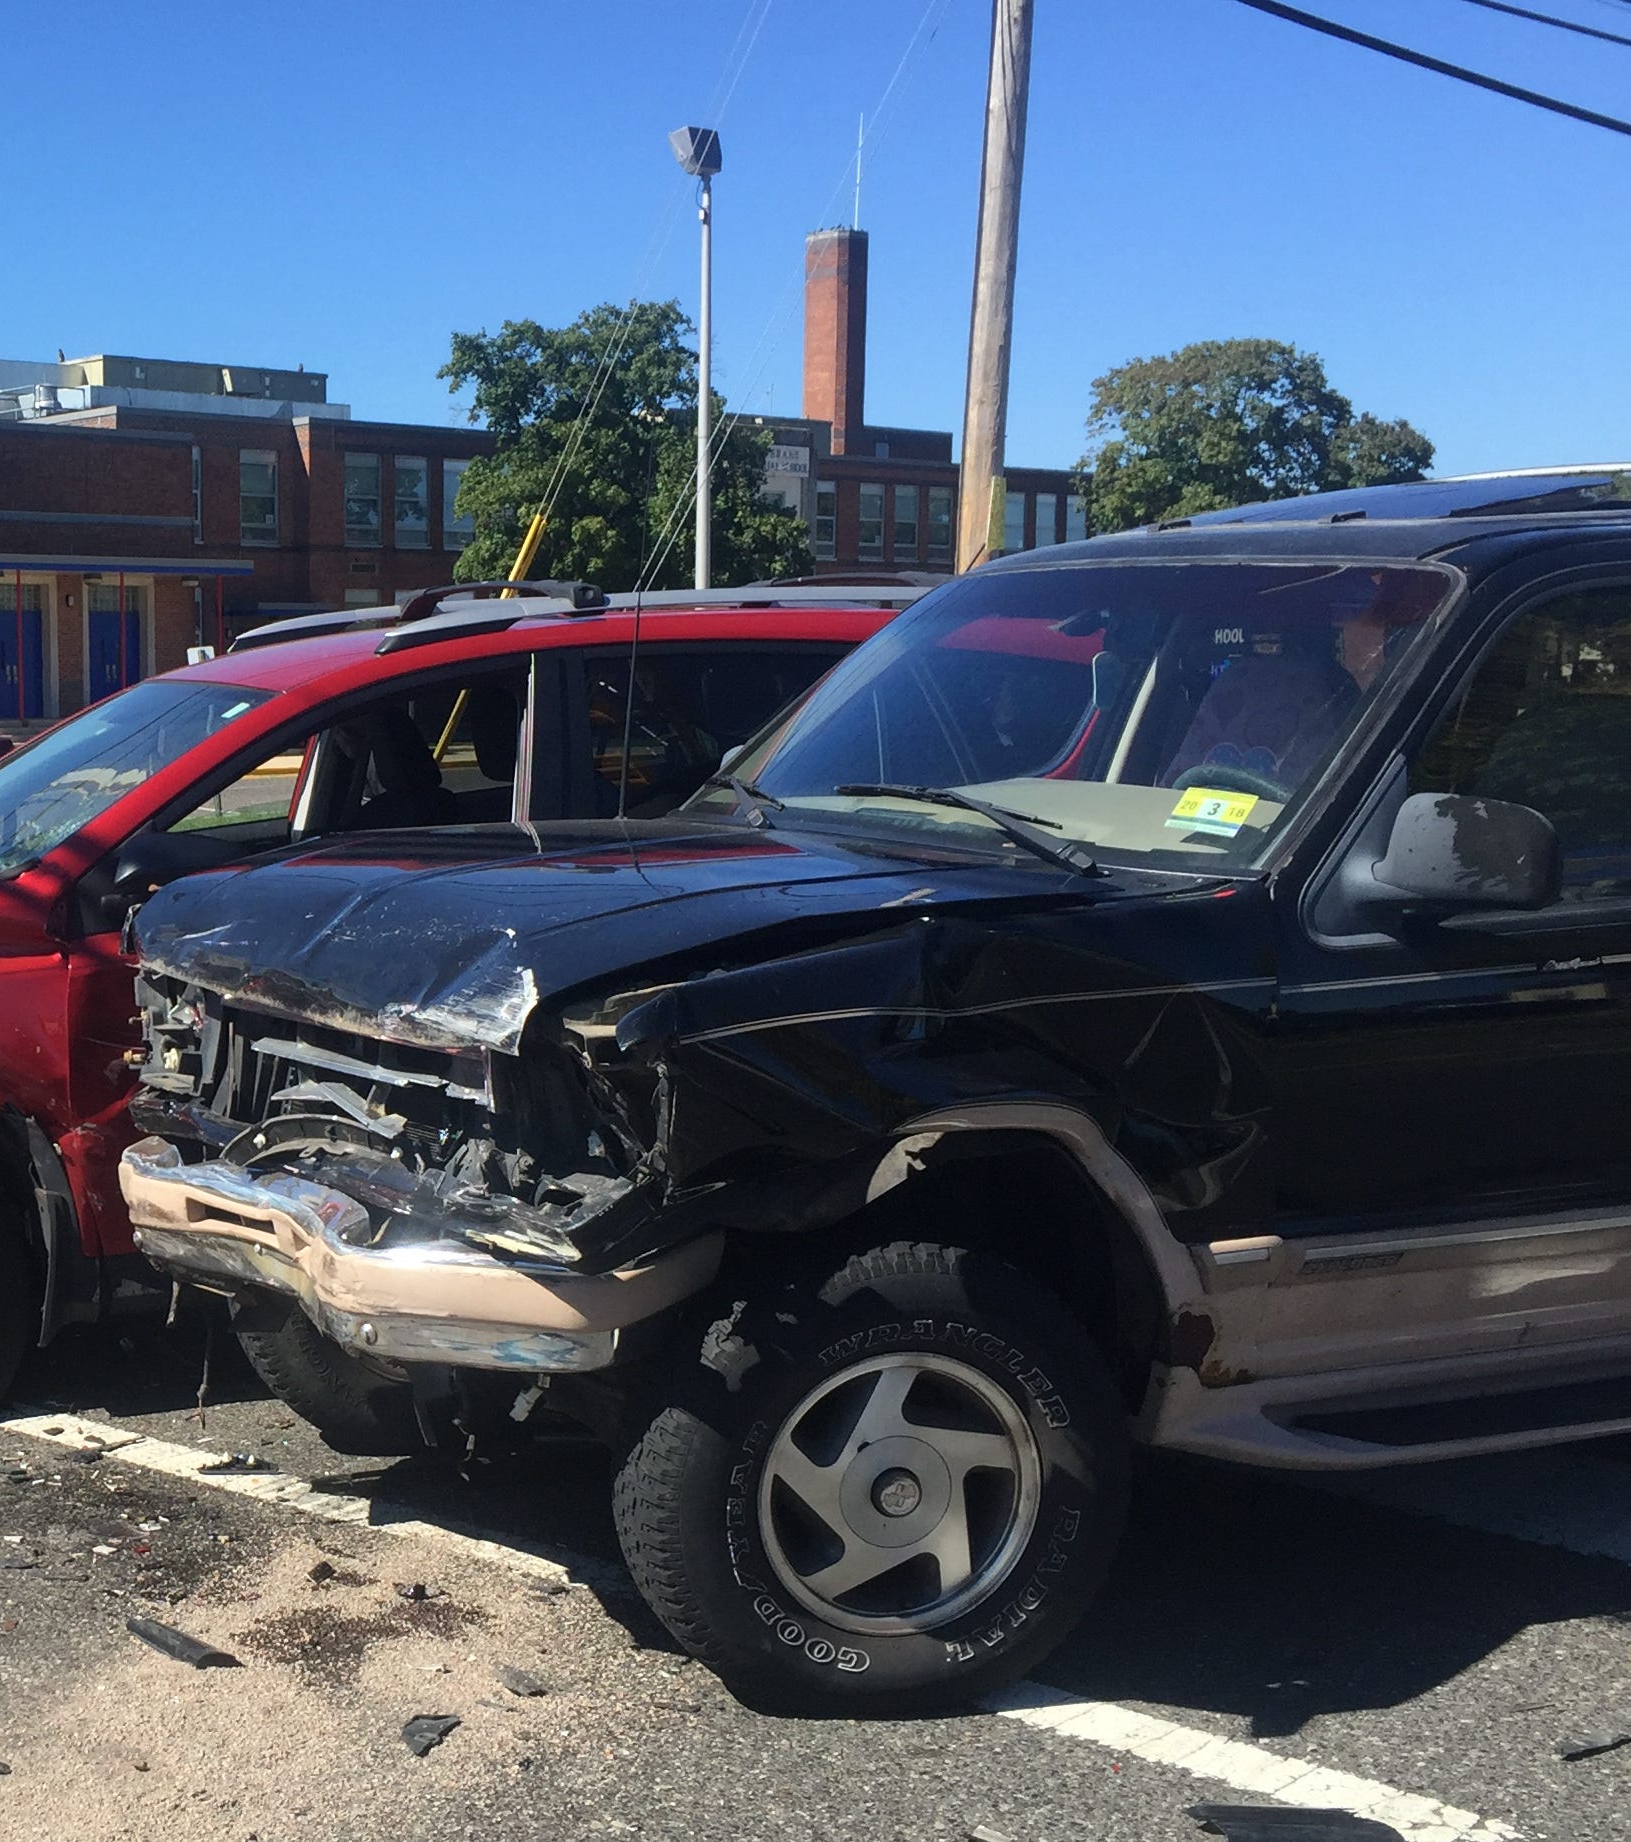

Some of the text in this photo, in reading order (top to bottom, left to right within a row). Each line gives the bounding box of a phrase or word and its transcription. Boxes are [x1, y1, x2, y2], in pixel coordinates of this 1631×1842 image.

[1180, 800, 1246, 818] 20 3 18
[817, 1319, 1071, 1430] WRANGLER
[943, 1505, 1082, 1664] RADIAL
